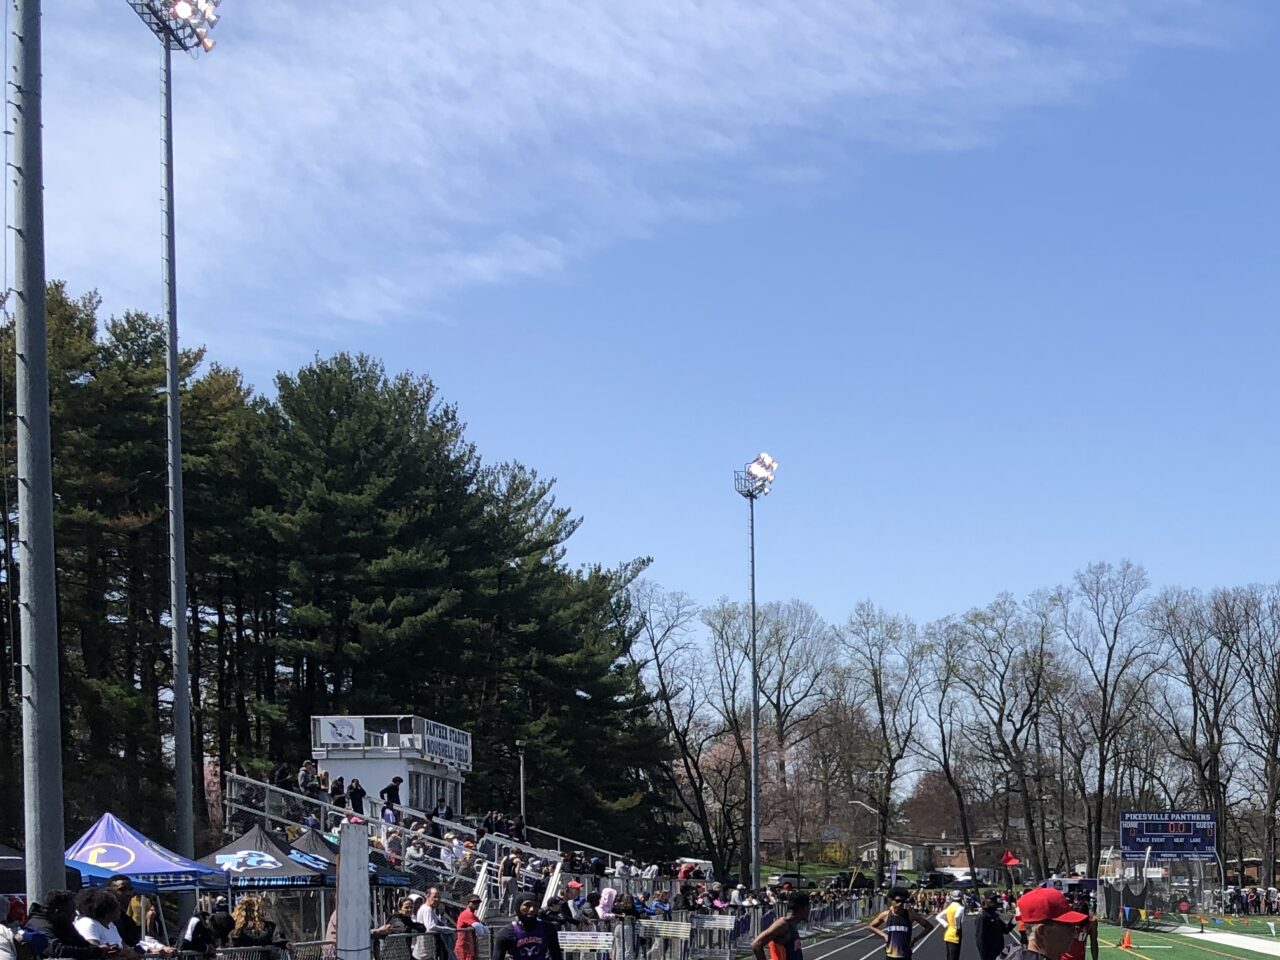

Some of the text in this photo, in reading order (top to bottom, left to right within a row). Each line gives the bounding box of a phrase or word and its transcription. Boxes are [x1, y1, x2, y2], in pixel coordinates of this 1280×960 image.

[426, 720, 448, 740] PANTHER
[454, 746, 469, 763] FIELD
[254, 876, 312, 886] TECHNOLOGY
